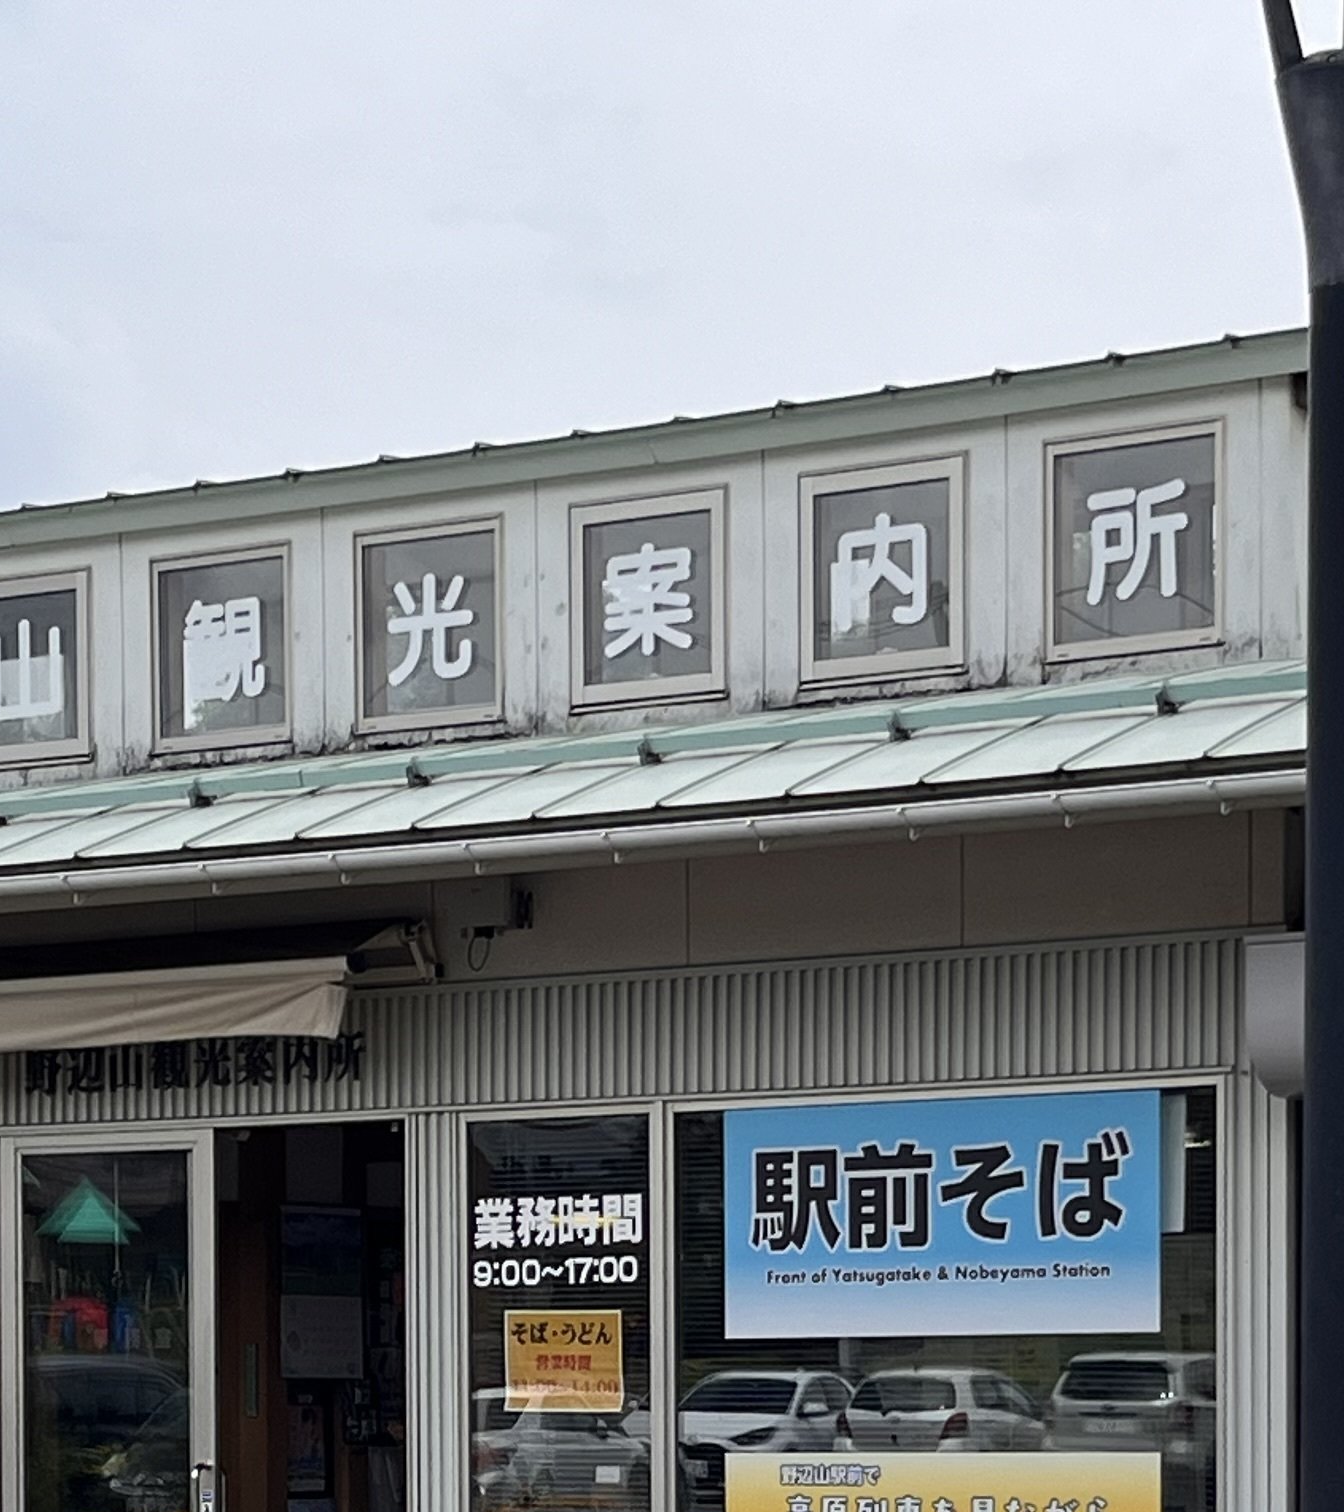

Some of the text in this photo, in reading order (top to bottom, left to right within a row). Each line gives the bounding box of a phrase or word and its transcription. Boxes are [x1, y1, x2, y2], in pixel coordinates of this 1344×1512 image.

[748, 1127, 1133, 1254] 駅前そば
[473, 1193, 644, 1249] 業務時間
[766, 1262, 1111, 1287] Front of Yatsugatake & Nobeyama Station
[511, 1322, 613, 1345] そば・うどん
[780, 1464, 881, 1486] 野辺山駅前で
